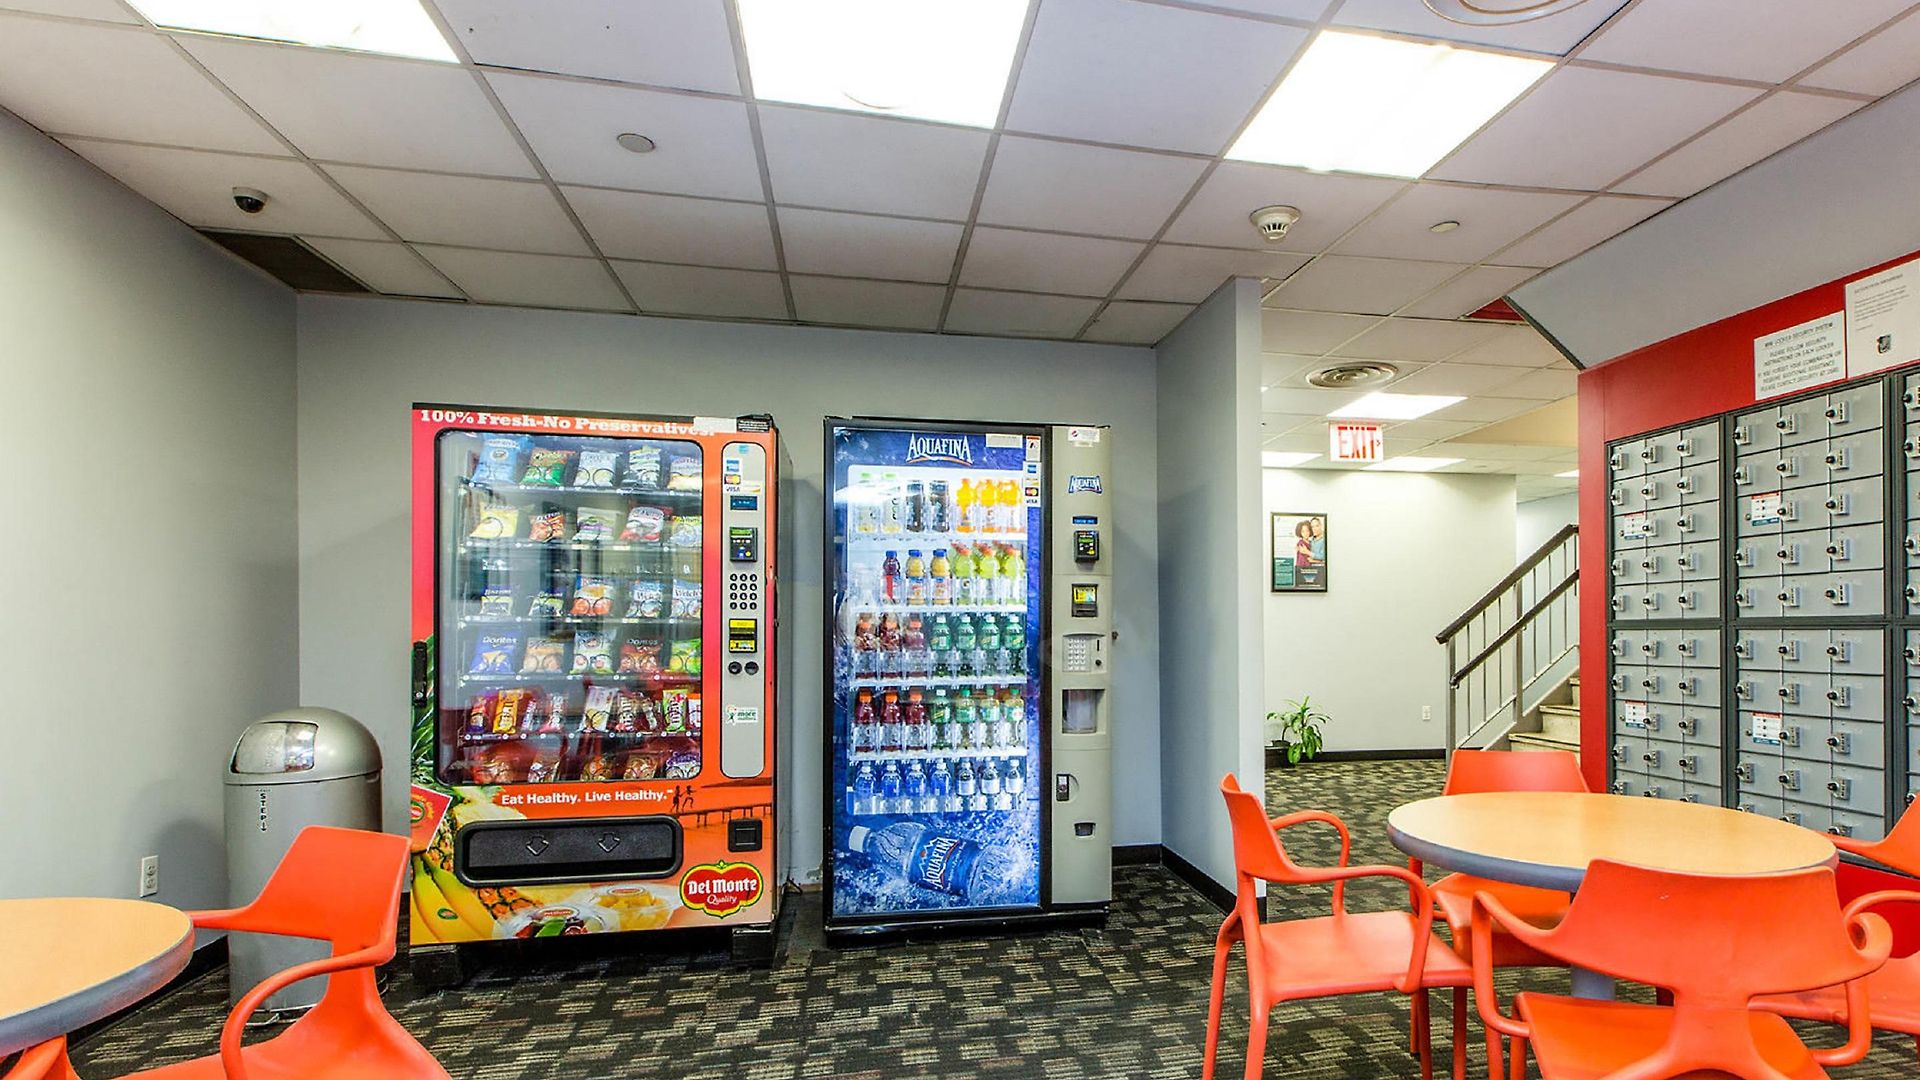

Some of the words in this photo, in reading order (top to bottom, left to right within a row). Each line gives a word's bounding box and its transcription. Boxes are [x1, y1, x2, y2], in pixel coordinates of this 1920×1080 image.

[421, 410, 474, 424] 100%
[906, 433, 974, 464] AQUAFINA
[1338, 426, 1376, 458] EXIT
[502, 794, 523, 804] Eat
[527, 792, 581, 804] Healthy.
[585, 792, 611, 802] Live
[923, 836, 958, 890] AQUAFINA
[687, 880, 711, 894] Del
[712, 878, 758, 894] Monte
[706, 894, 738, 905] Quality
